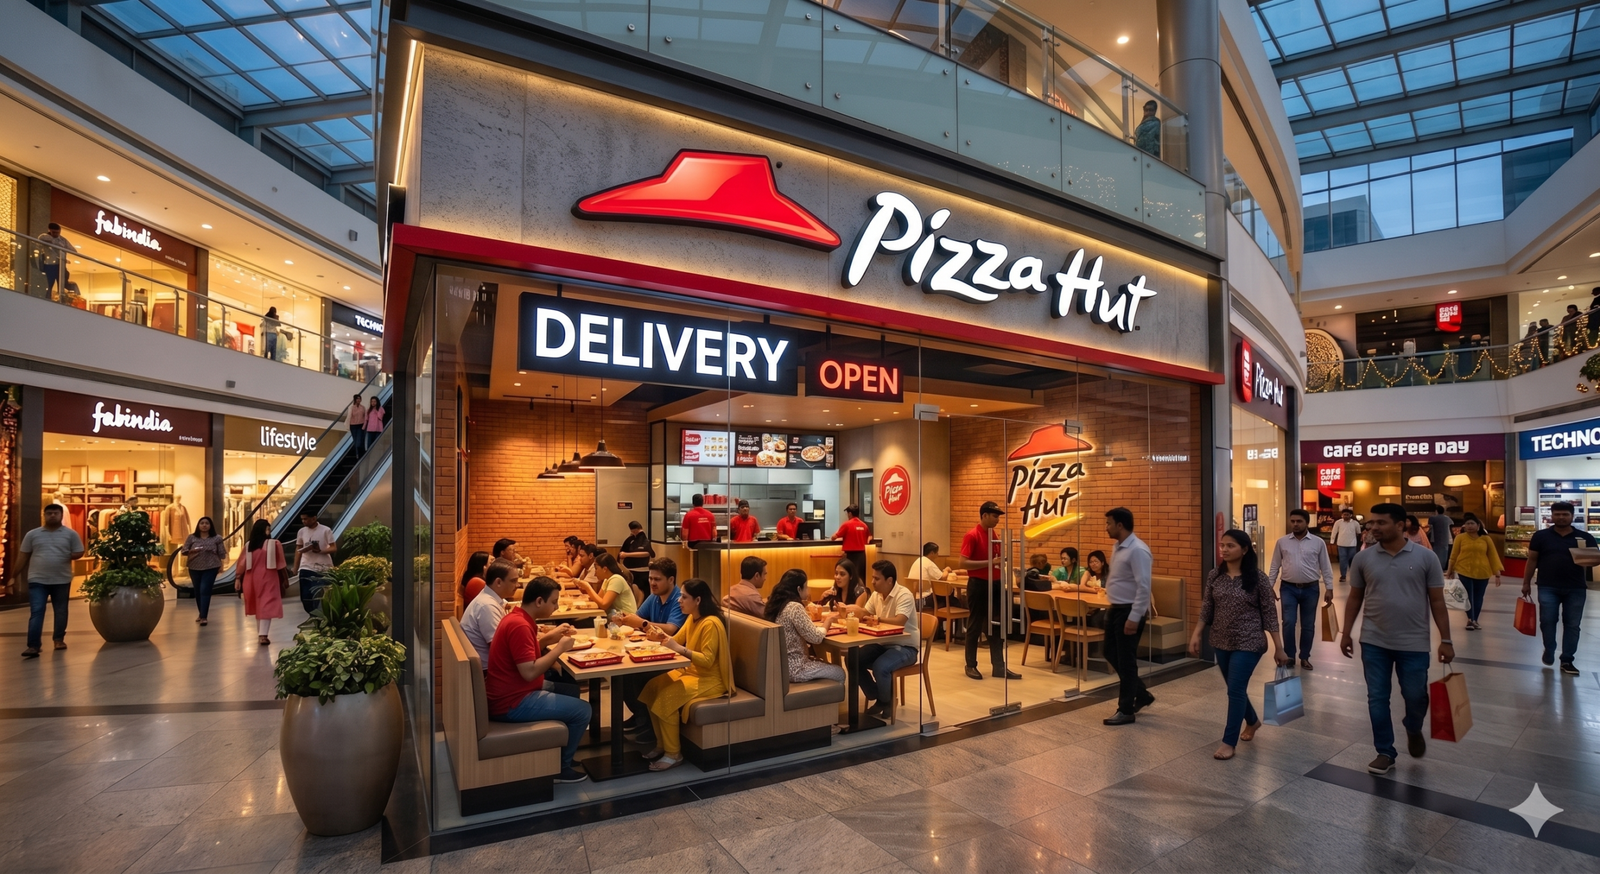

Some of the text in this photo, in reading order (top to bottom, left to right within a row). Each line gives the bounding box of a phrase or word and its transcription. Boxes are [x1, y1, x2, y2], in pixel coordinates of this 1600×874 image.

[95, 210, 162, 251] fabindia
[845, 191, 1158, 333] Pizza Hut
[535, 308, 789, 382] DELIVERY
[819, 360, 898, 396] OPEN
[92, 402, 173, 433] fabindia
[260, 425, 317, 454] lifestyle
[1007, 457, 1086, 505] Pizza
[1020, 487, 1079, 525] Hut
